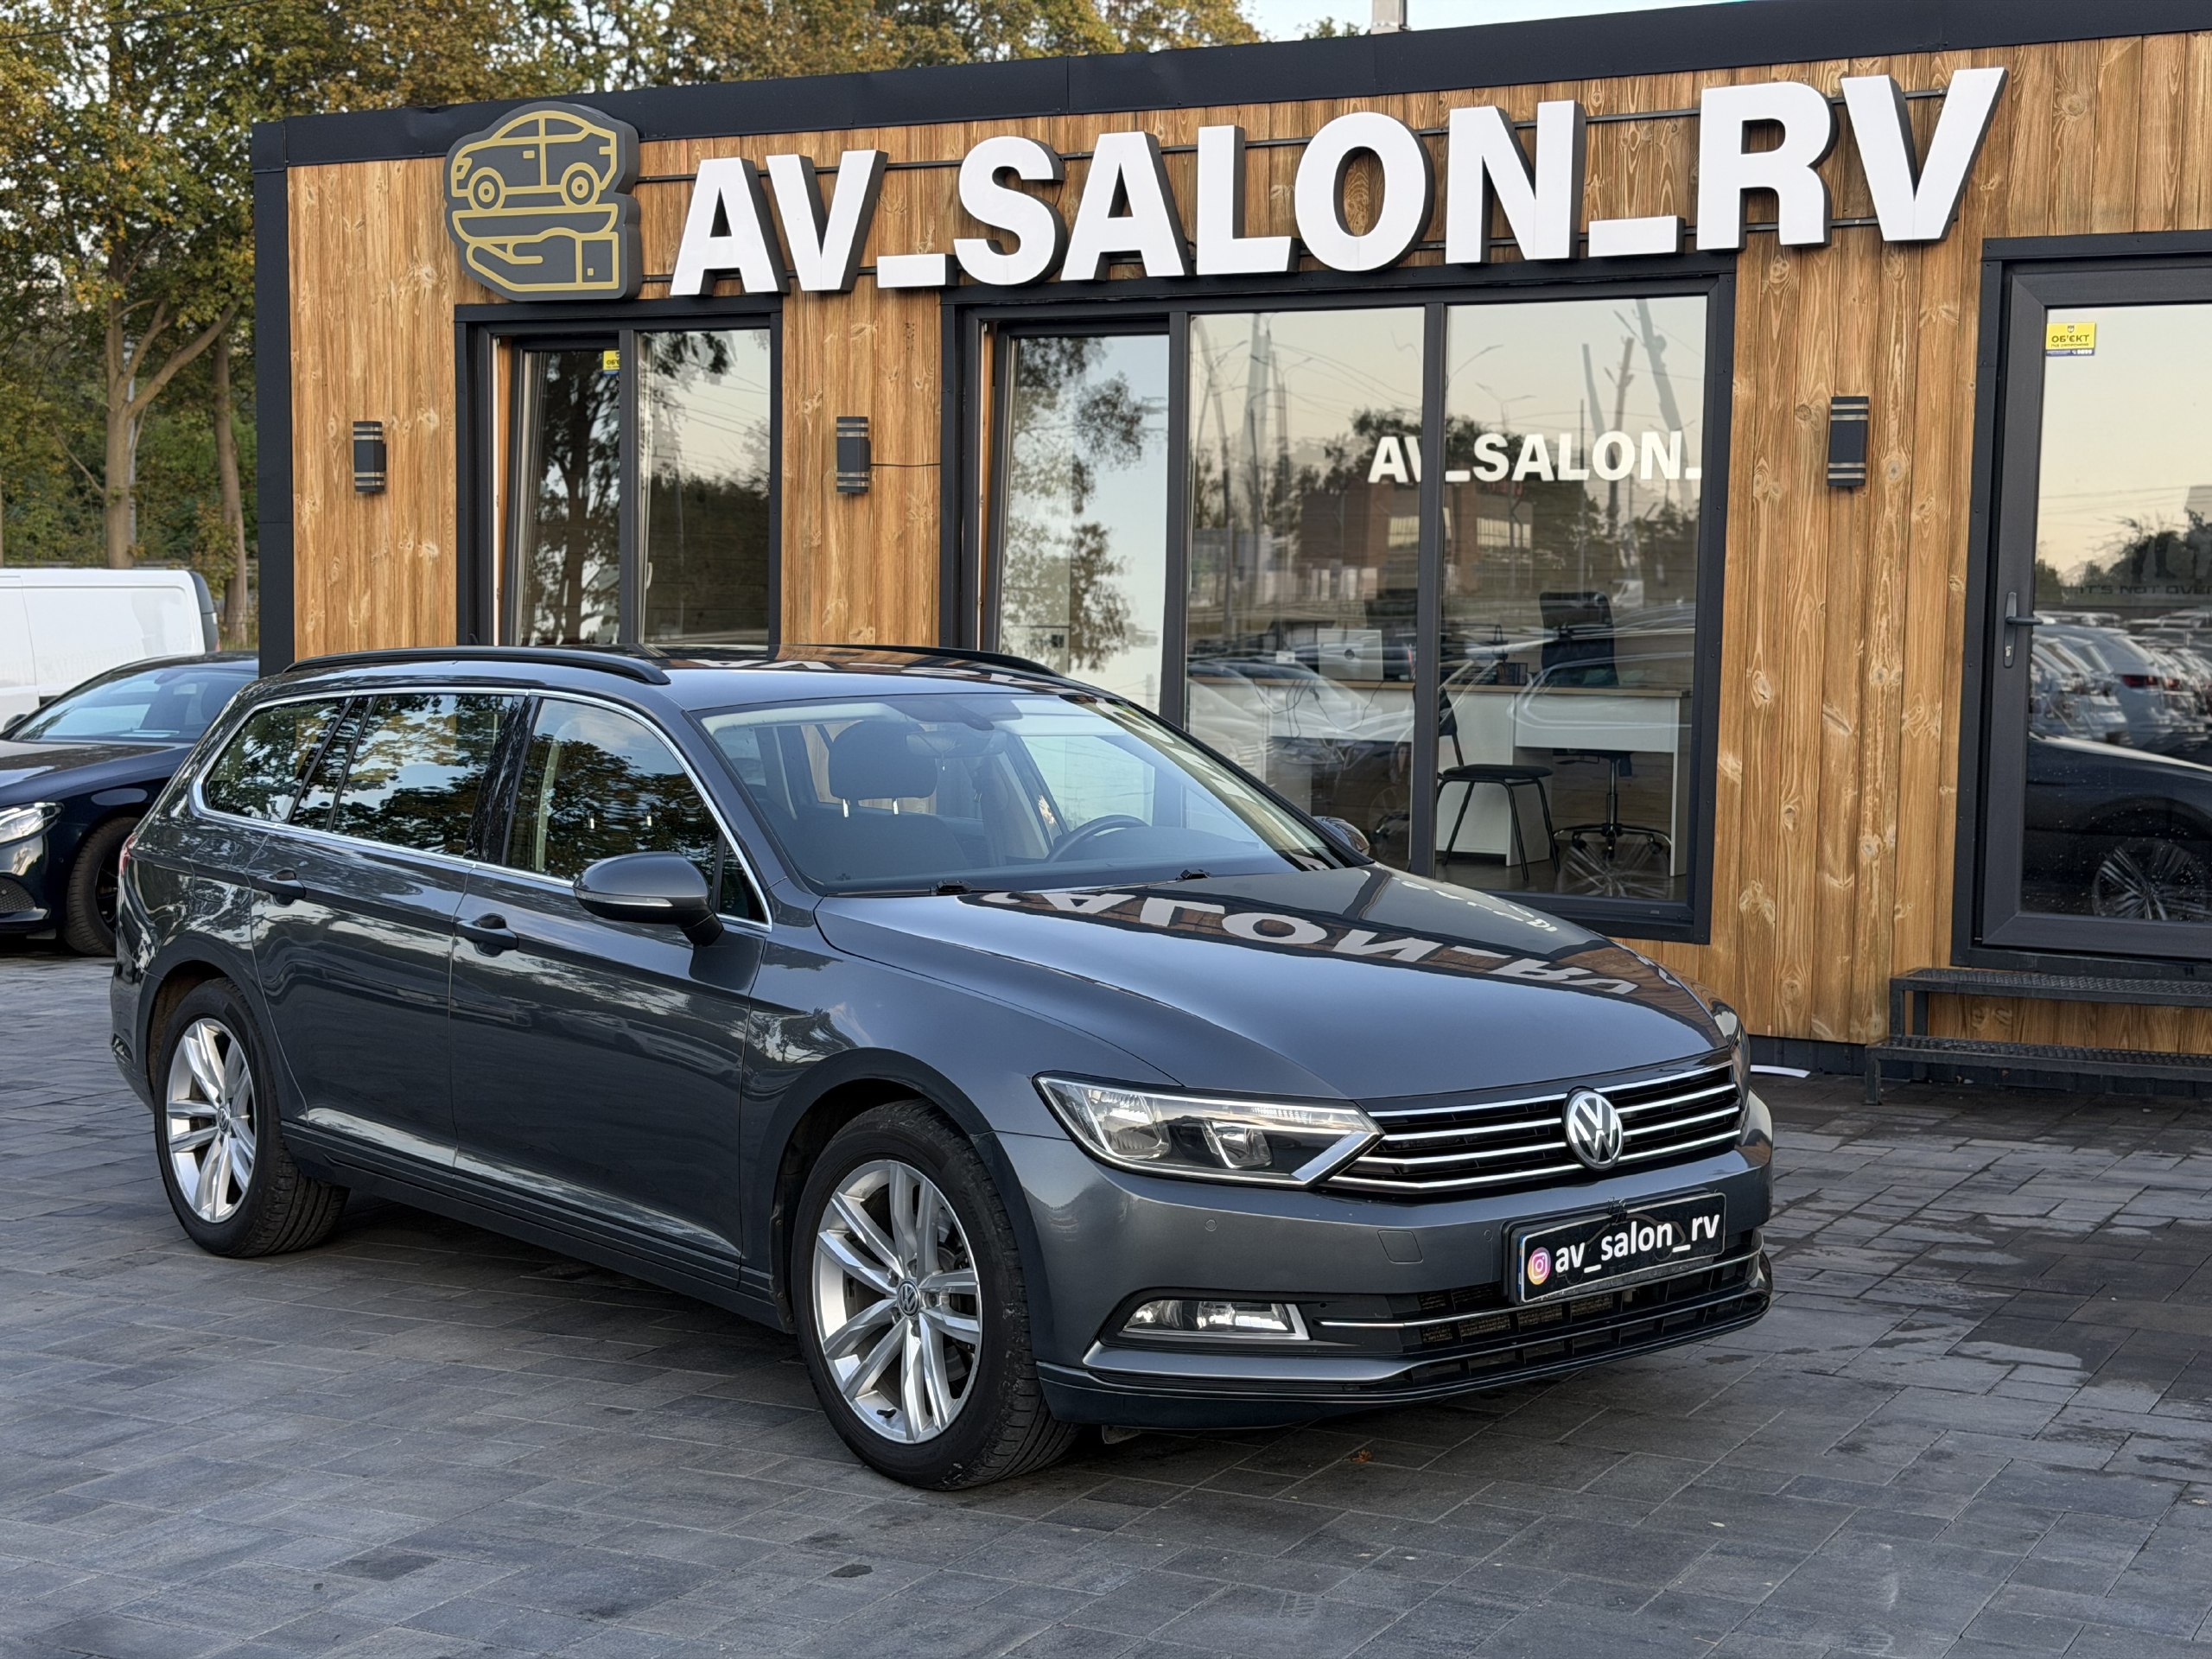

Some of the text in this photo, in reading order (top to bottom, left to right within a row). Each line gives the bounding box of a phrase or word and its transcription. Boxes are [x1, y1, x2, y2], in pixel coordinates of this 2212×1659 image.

[670, 66, 2008, 296] AV_SALON_RV
[2051, 334, 2090, 343] ОБ'ЄКТ
[1555, 1214, 1719, 1274] av_salon_rv
